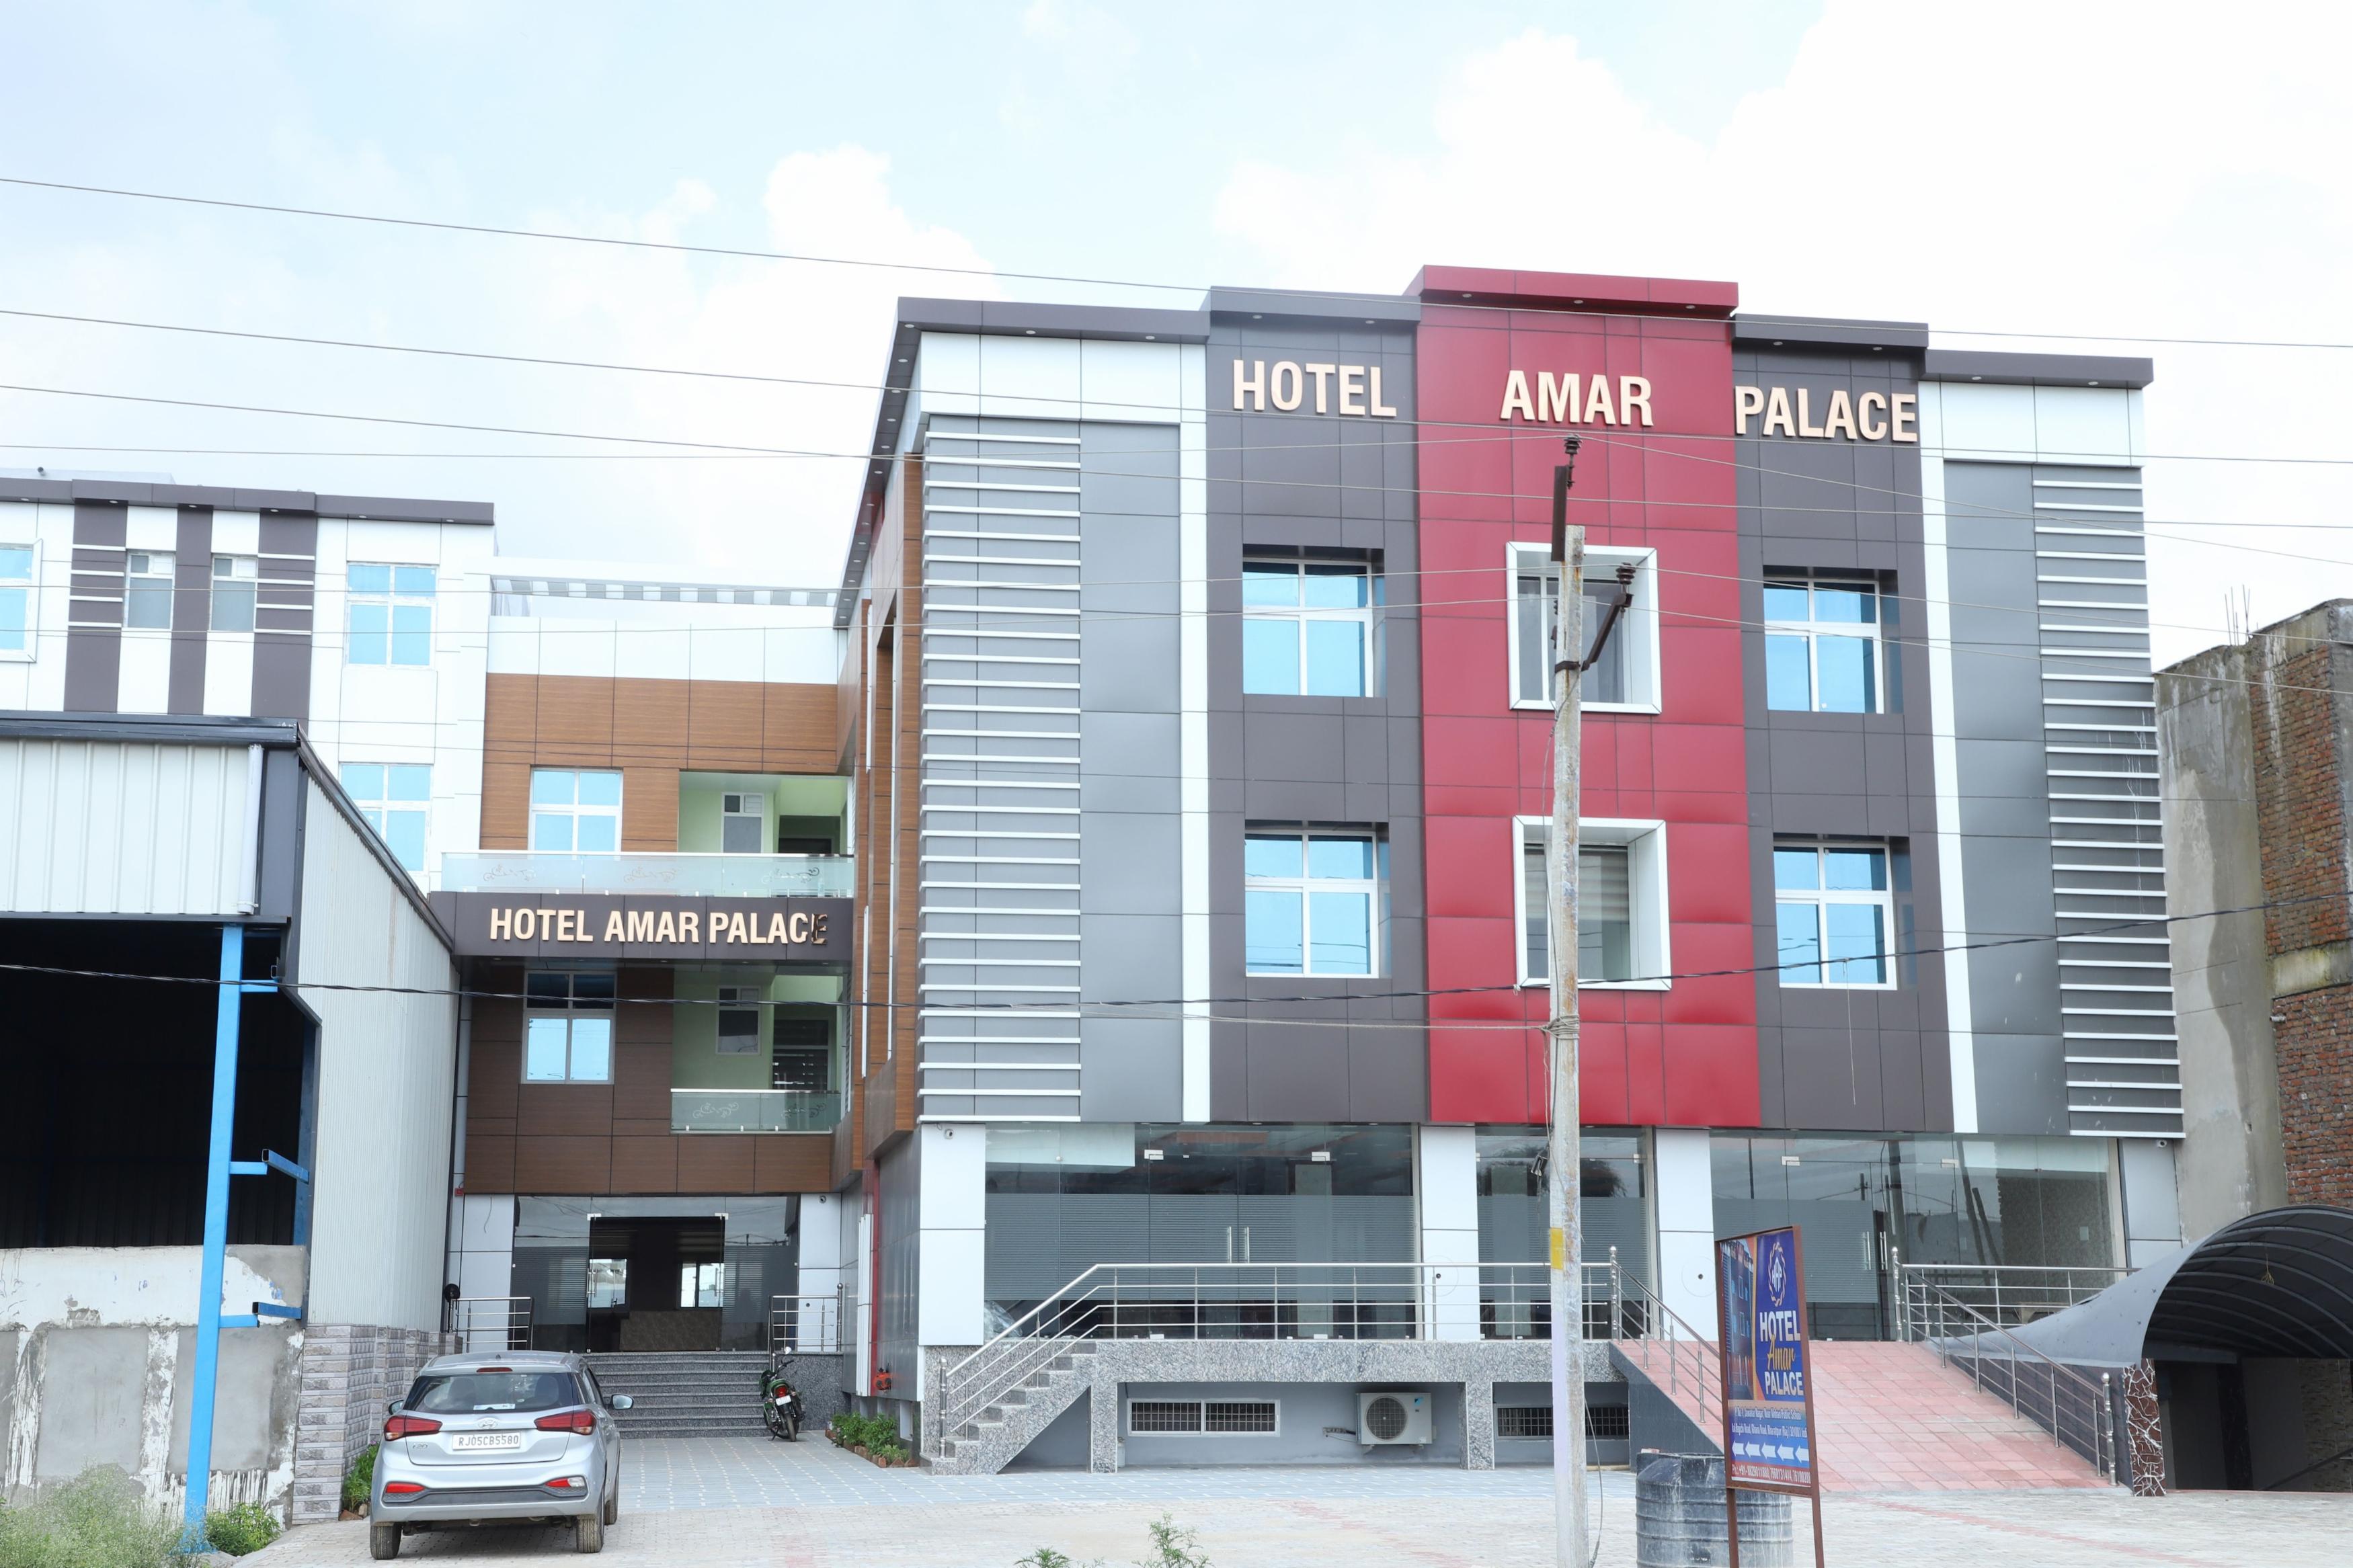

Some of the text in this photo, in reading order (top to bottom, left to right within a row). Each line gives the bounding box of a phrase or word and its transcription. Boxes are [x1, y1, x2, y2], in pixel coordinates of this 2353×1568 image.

[1233, 359, 1918, 443] HOTEL AMAR PALACE
[489, 908, 828, 945] HOTEL AMAR PALACE
[1759, 1310, 1802, 1343] HOTEL
[1767, 1333, 1796, 1371] Amar
[1764, 1371, 1804, 1397] PALACE
[1781, 1408, 1790, 1419] Public
[1790, 1409, 1802, 1420] School
[458, 1435, 519, 1447] RJ05CB5580
